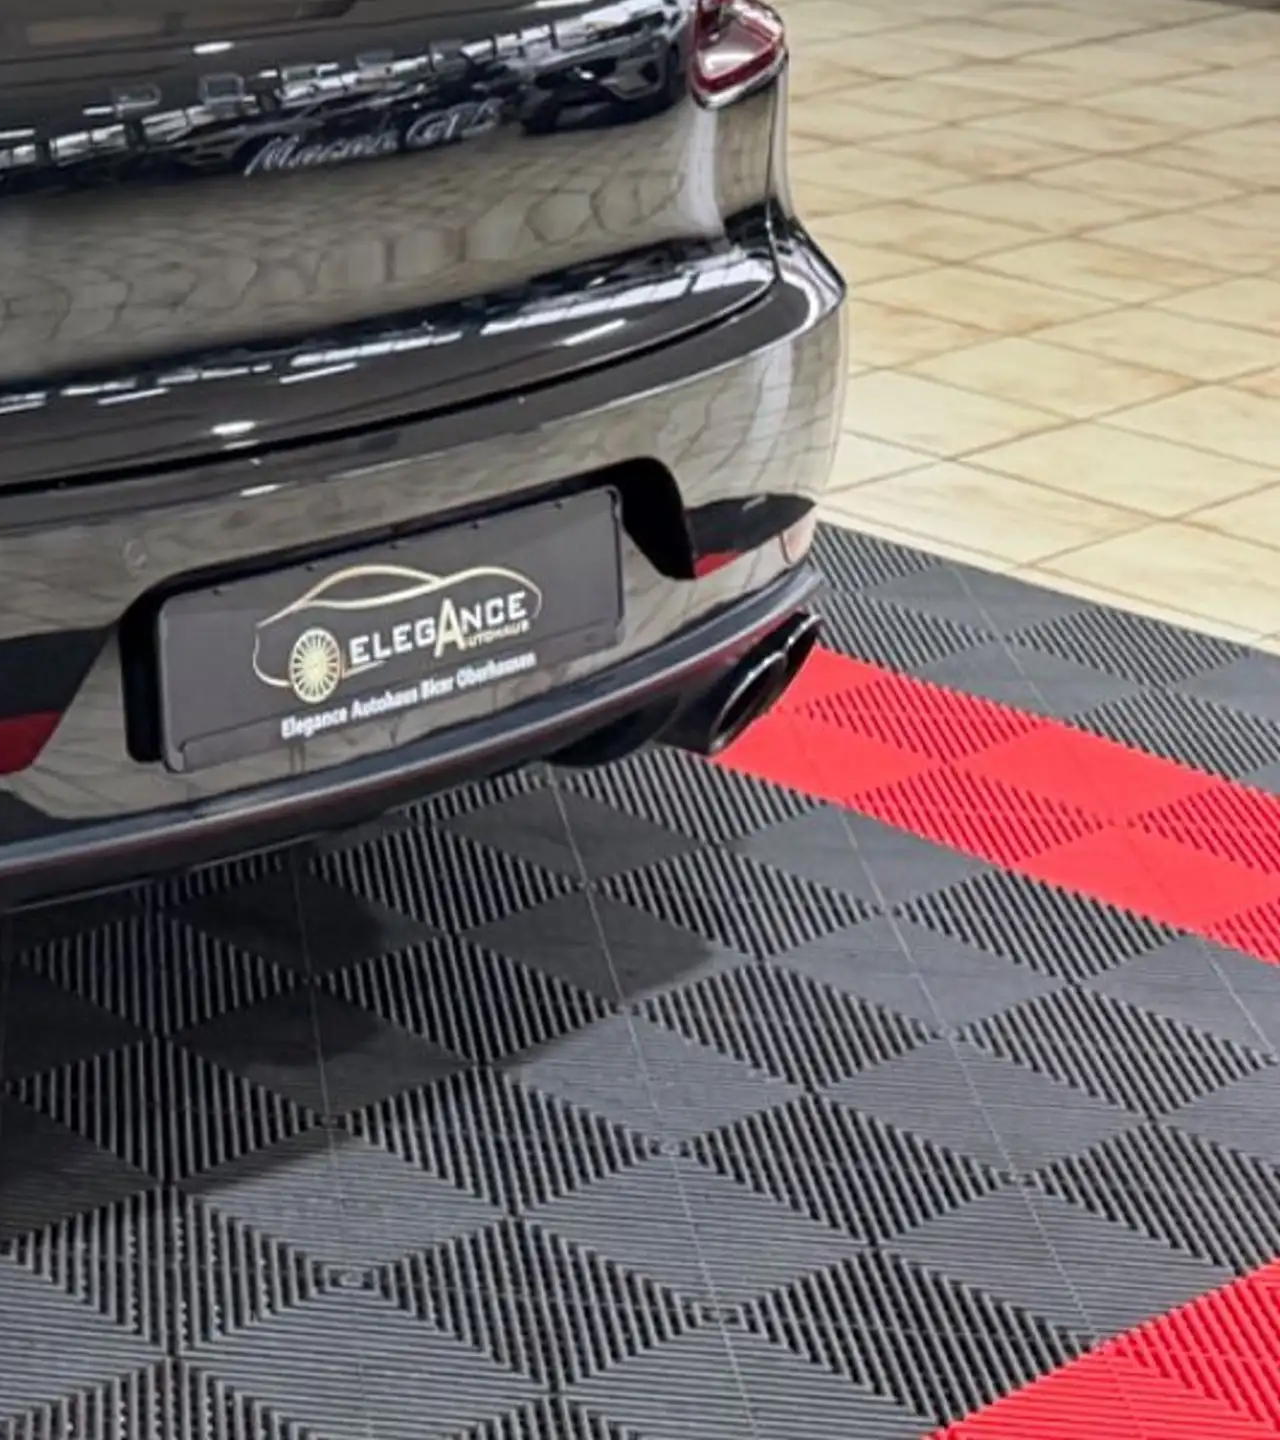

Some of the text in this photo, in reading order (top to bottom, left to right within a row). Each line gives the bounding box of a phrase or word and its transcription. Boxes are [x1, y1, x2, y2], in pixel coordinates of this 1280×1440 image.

[349, 590, 527, 665] ELEGANCE
[281, 707, 348, 738] Elegance
[351, 688, 417, 719] Autohaus
